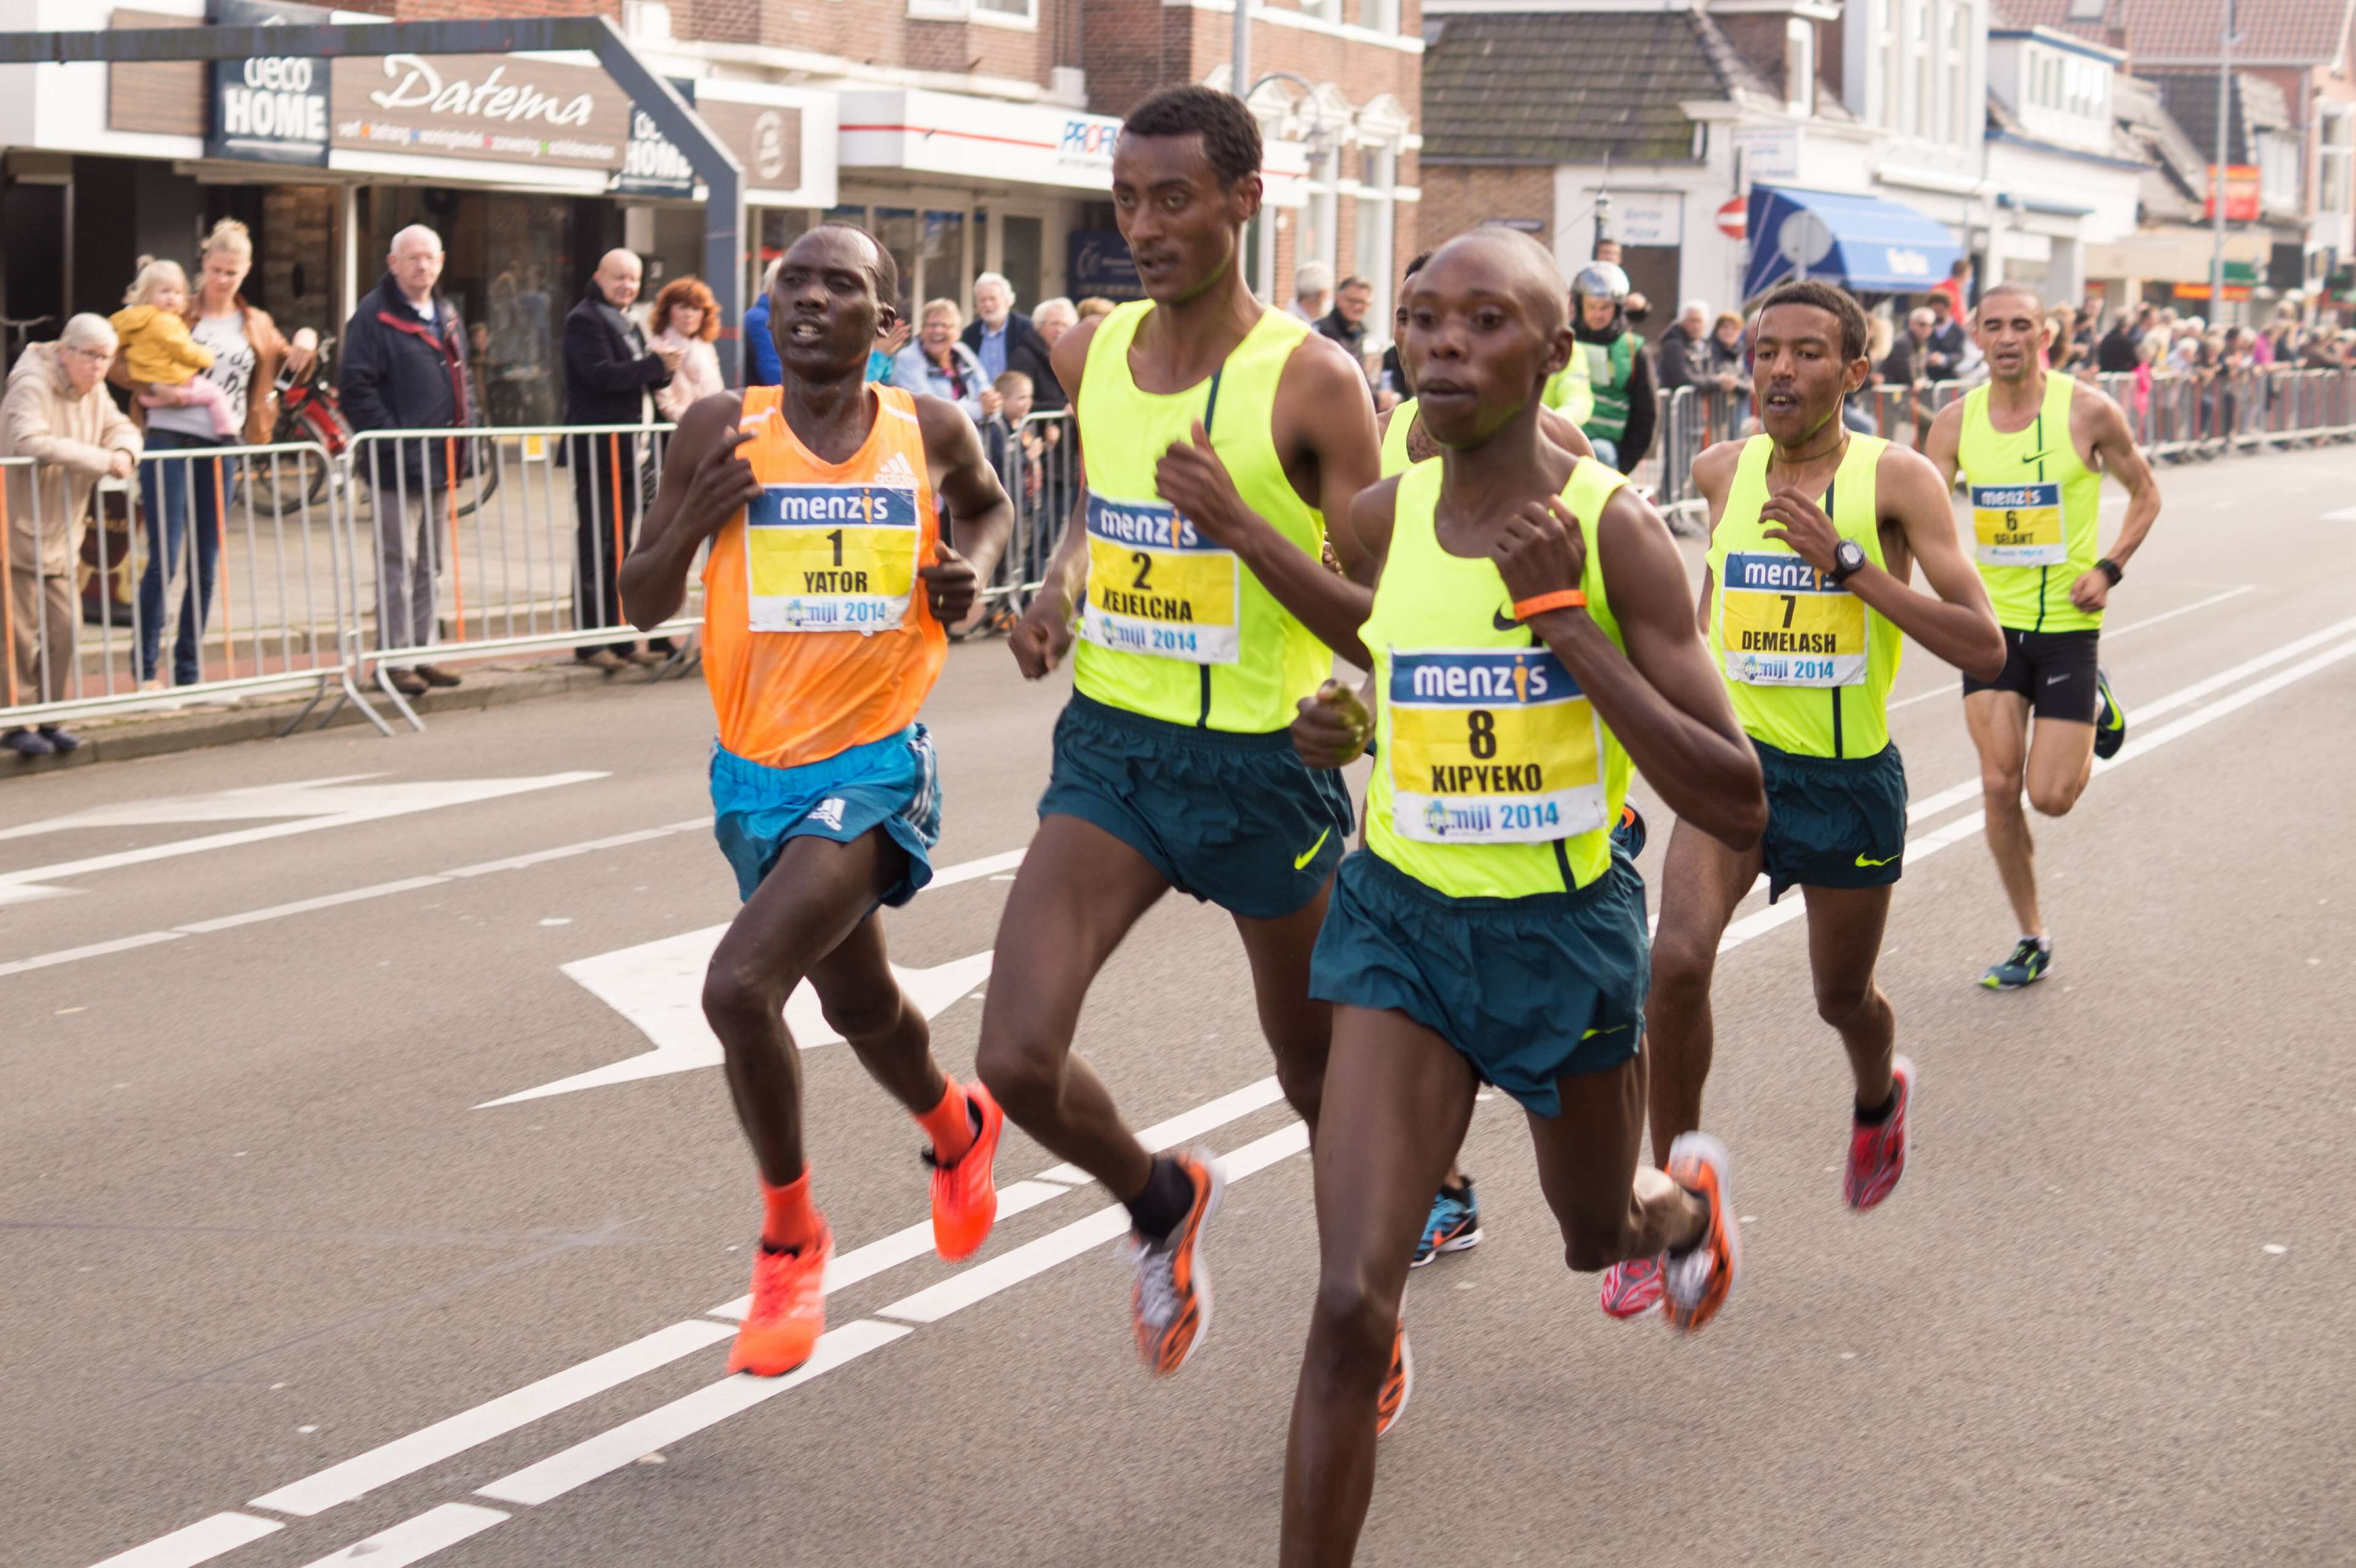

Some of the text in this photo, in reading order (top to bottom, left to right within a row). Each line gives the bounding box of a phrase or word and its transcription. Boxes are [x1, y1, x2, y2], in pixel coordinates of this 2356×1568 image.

[370, 53, 593, 126] Datema
[225, 88, 327, 139] HOME
[780, 488, 888, 524] menzis
[1981, 486, 2041, 506] menzis
[1100, 508, 1198, 550] menzis
[2006, 510, 2018, 531] 6
[826, 529, 842, 567] 1
[804, 571, 867, 593] YATOR
[1132, 552, 1152, 590] 2
[1745, 563, 1835, 591] menzi
[844, 602, 885, 621] 2014
[1780, 595, 1796, 628] 7
[1153, 628, 1196, 651] 2014
[1742, 630, 1836, 653] DEMELASH
[1414, 655, 1549, 702] menzis
[1794, 660, 1834, 679] 2014
[1468, 710, 1496, 759] 8
[1431, 764, 1542, 793] KIPYEKO
[1500, 801, 1559, 829] 2014
